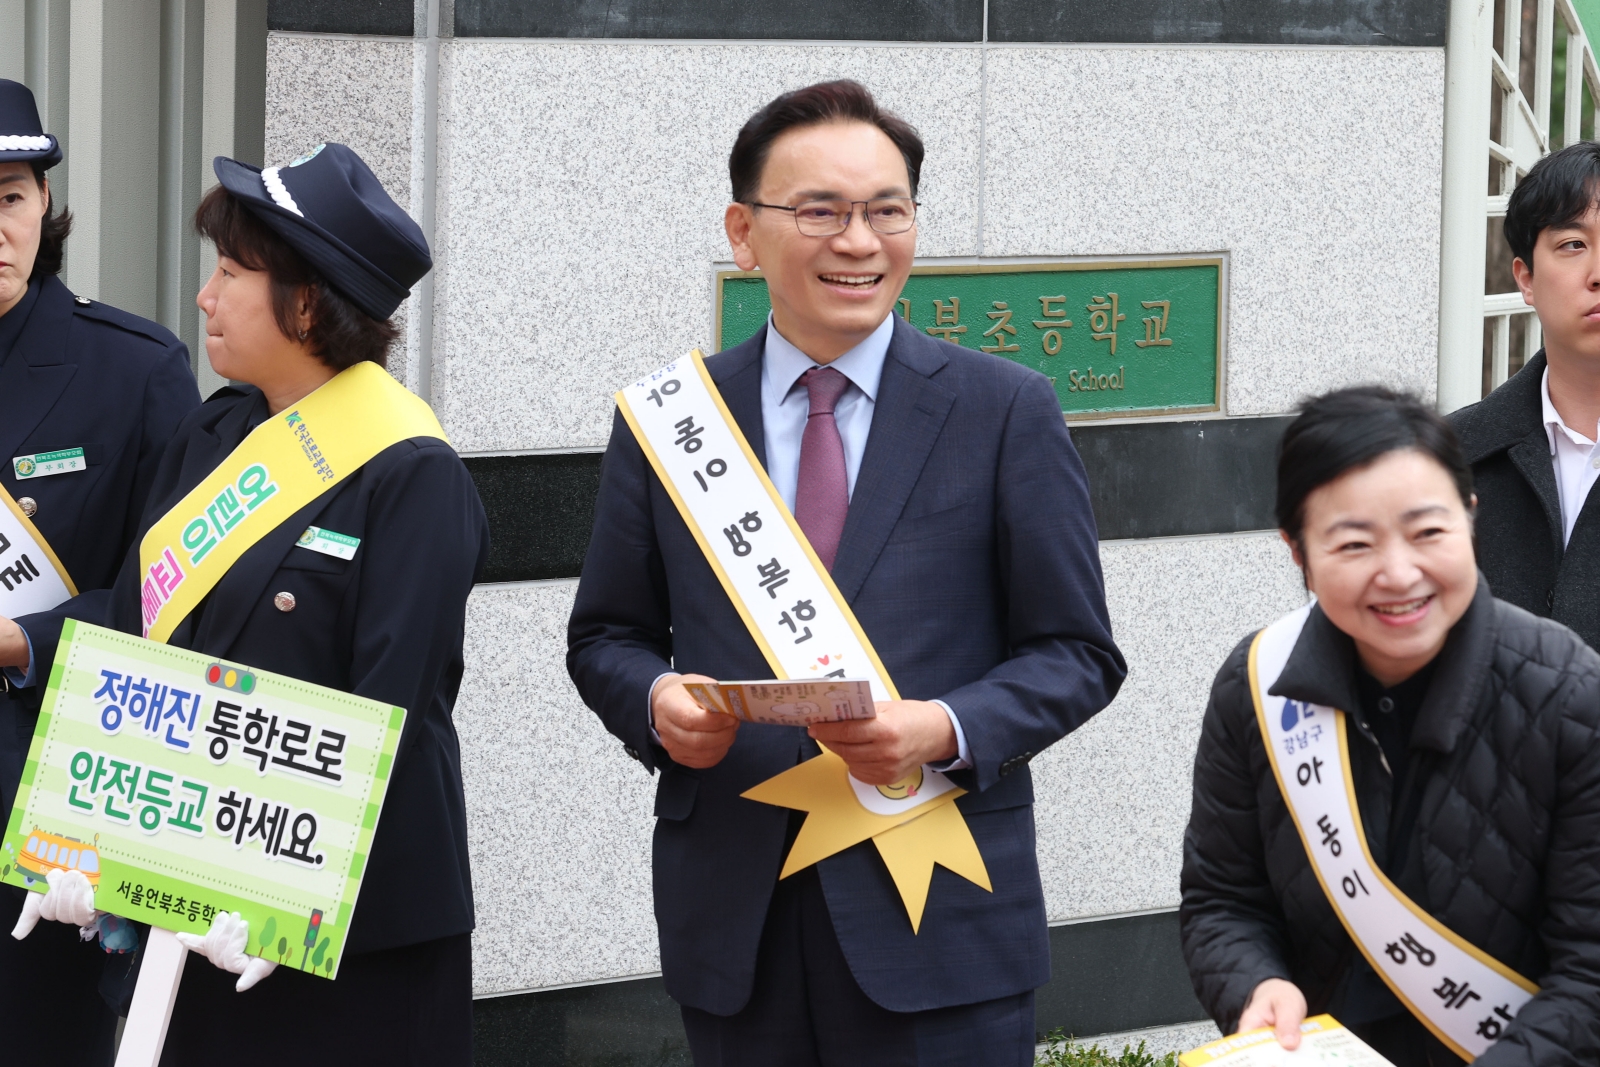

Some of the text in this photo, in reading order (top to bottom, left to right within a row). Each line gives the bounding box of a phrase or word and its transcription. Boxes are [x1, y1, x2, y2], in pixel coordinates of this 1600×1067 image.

[898, 292, 1173, 355] 북초등학교
[1069, 366, 1125, 393] School
[294, 423, 335, 482] 한국도로교통공단
[182, 465, 277, 565] 어린이
[94, 669, 346, 781] 정해진 통학로로
[1283, 724, 1323, 755] 강남구
[68, 751, 323, 865] 안전등교 하세요.
[116, 881, 229, 927] 서울언북초등학
